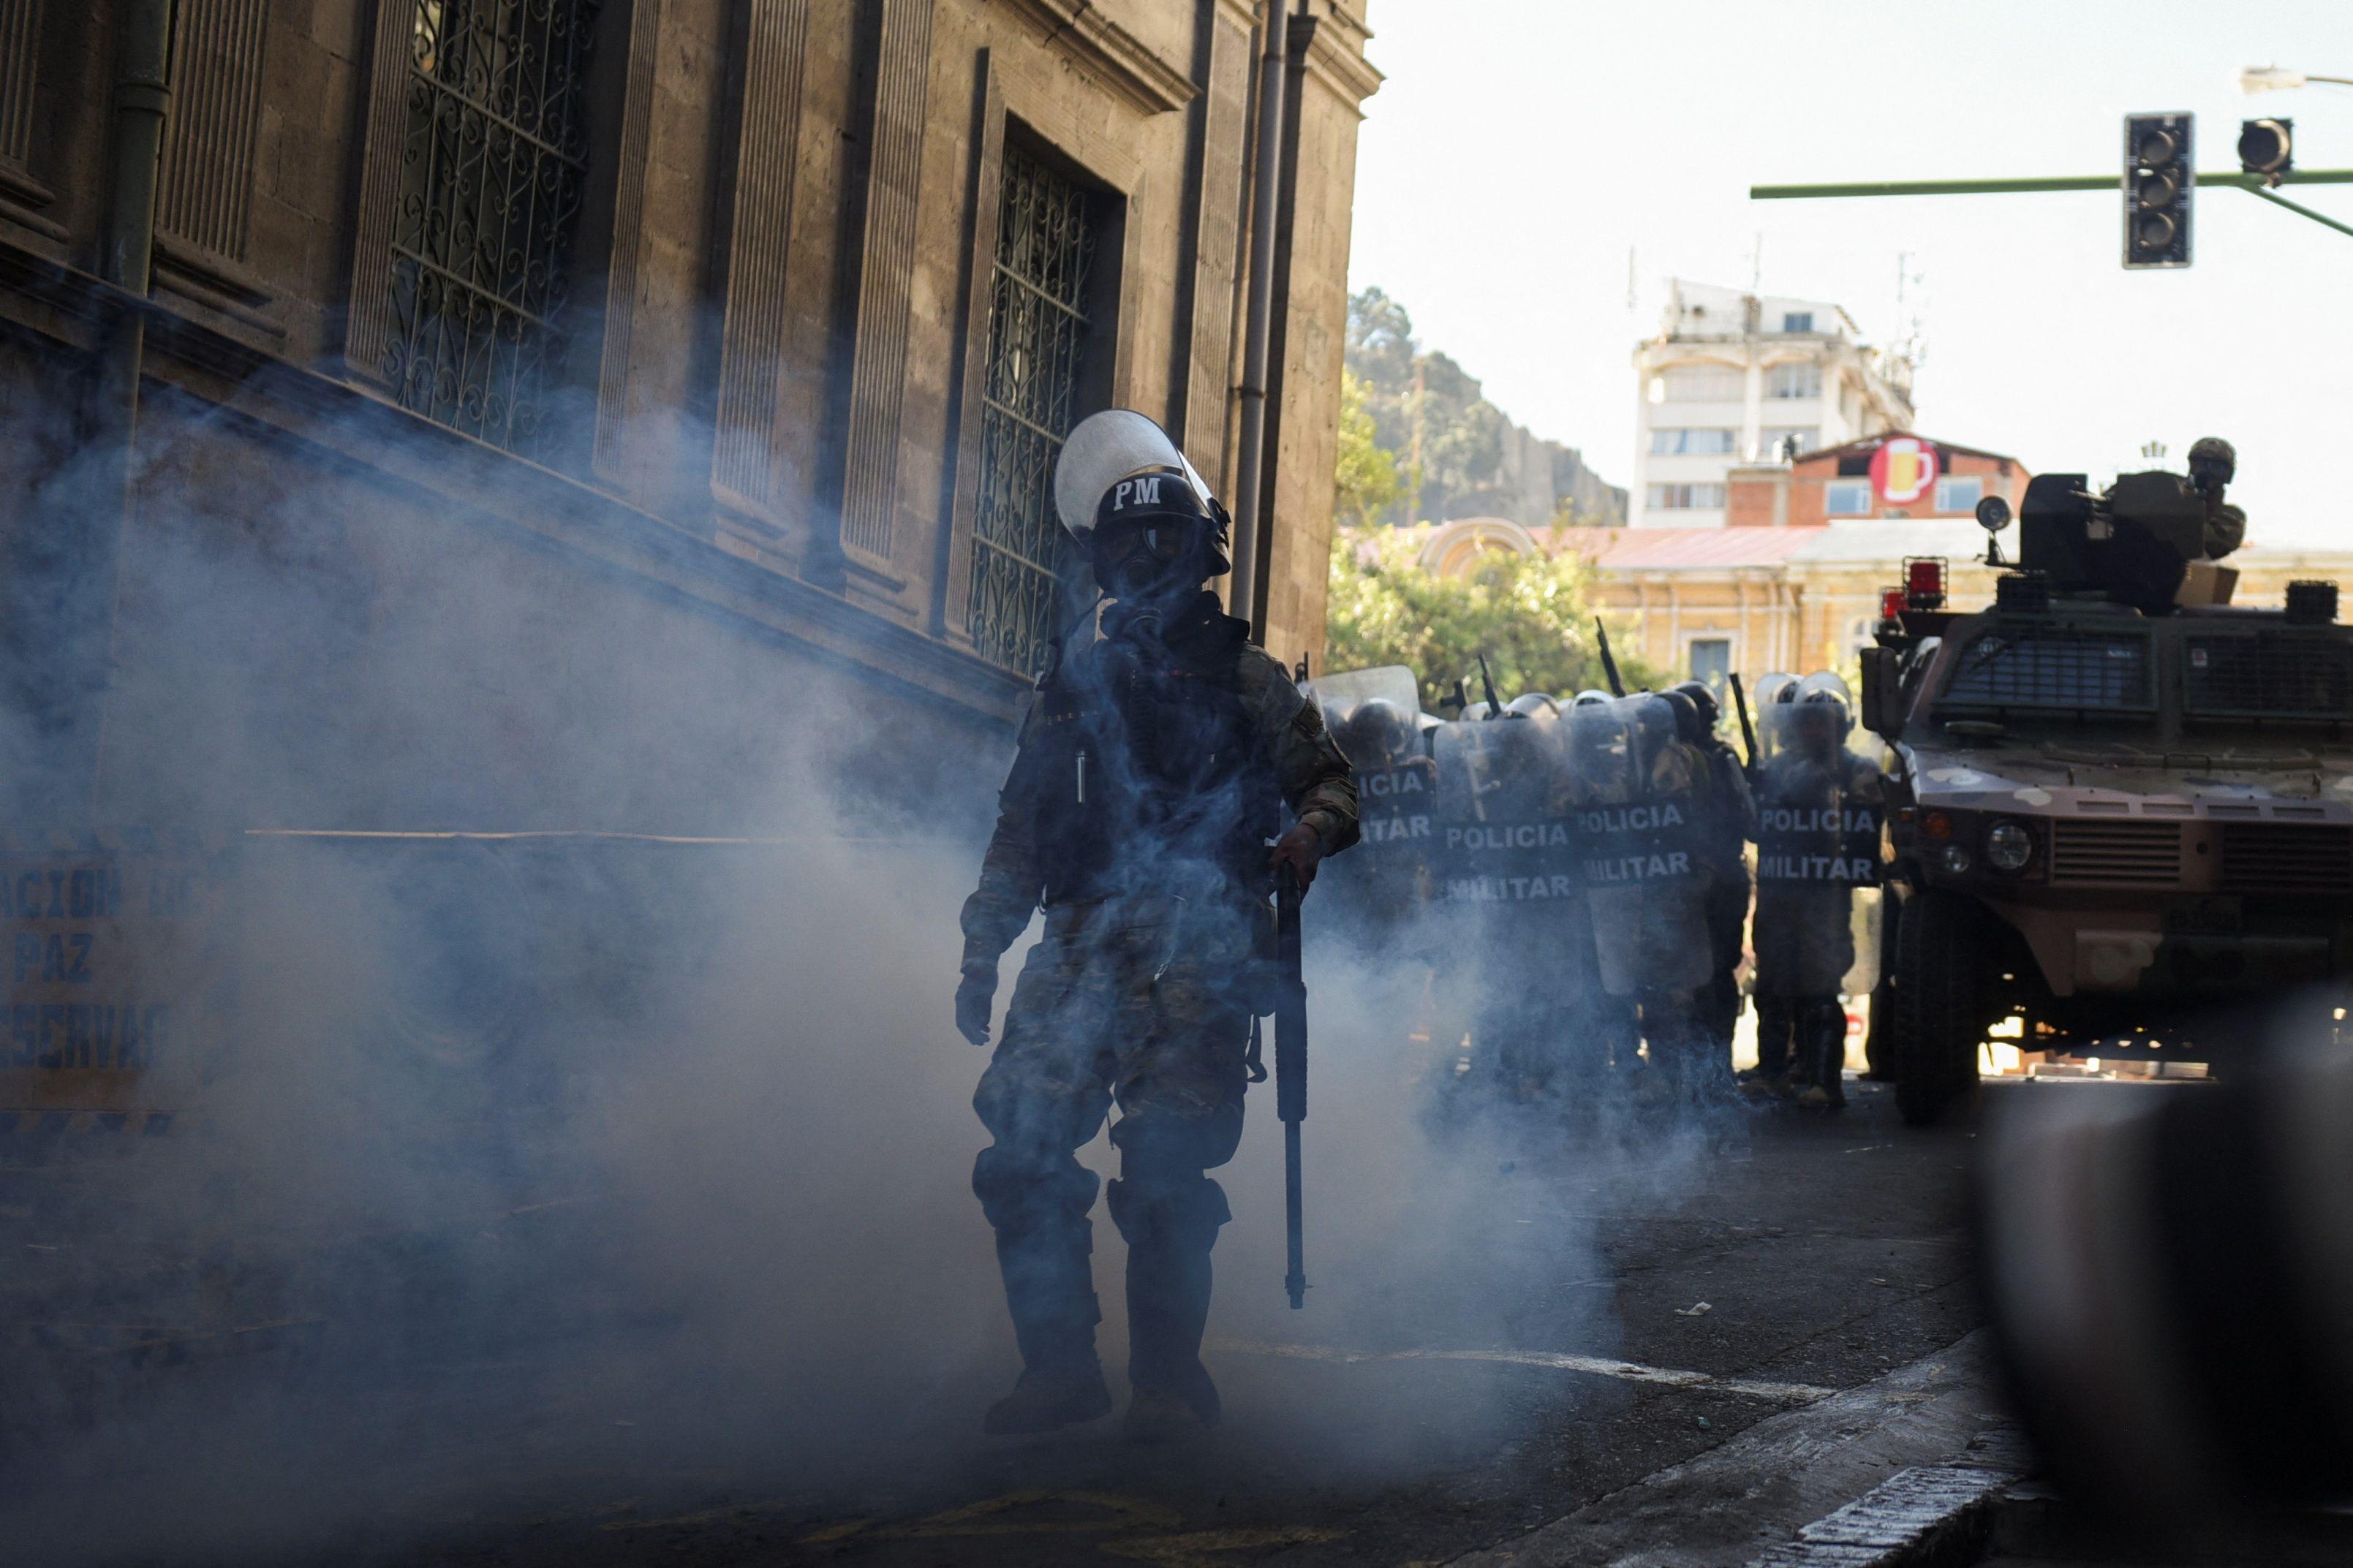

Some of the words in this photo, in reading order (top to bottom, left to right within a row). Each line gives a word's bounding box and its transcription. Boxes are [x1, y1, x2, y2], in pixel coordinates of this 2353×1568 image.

[1113, 477, 1161, 512] PM
[1358, 771, 1423, 798] ICIA
[1357, 816, 1431, 843] ITAR
[1577, 804, 1683, 832] POLICIA
[1760, 809, 1876, 832] POLICIA
[1446, 825, 1568, 849] POLICIA
[1585, 852, 1691, 881] MILITAR
[1759, 856, 1874, 879] MILITAR
[1447, 876, 1570, 901] MILITAR
[15, 933, 93, 982] PAZ
